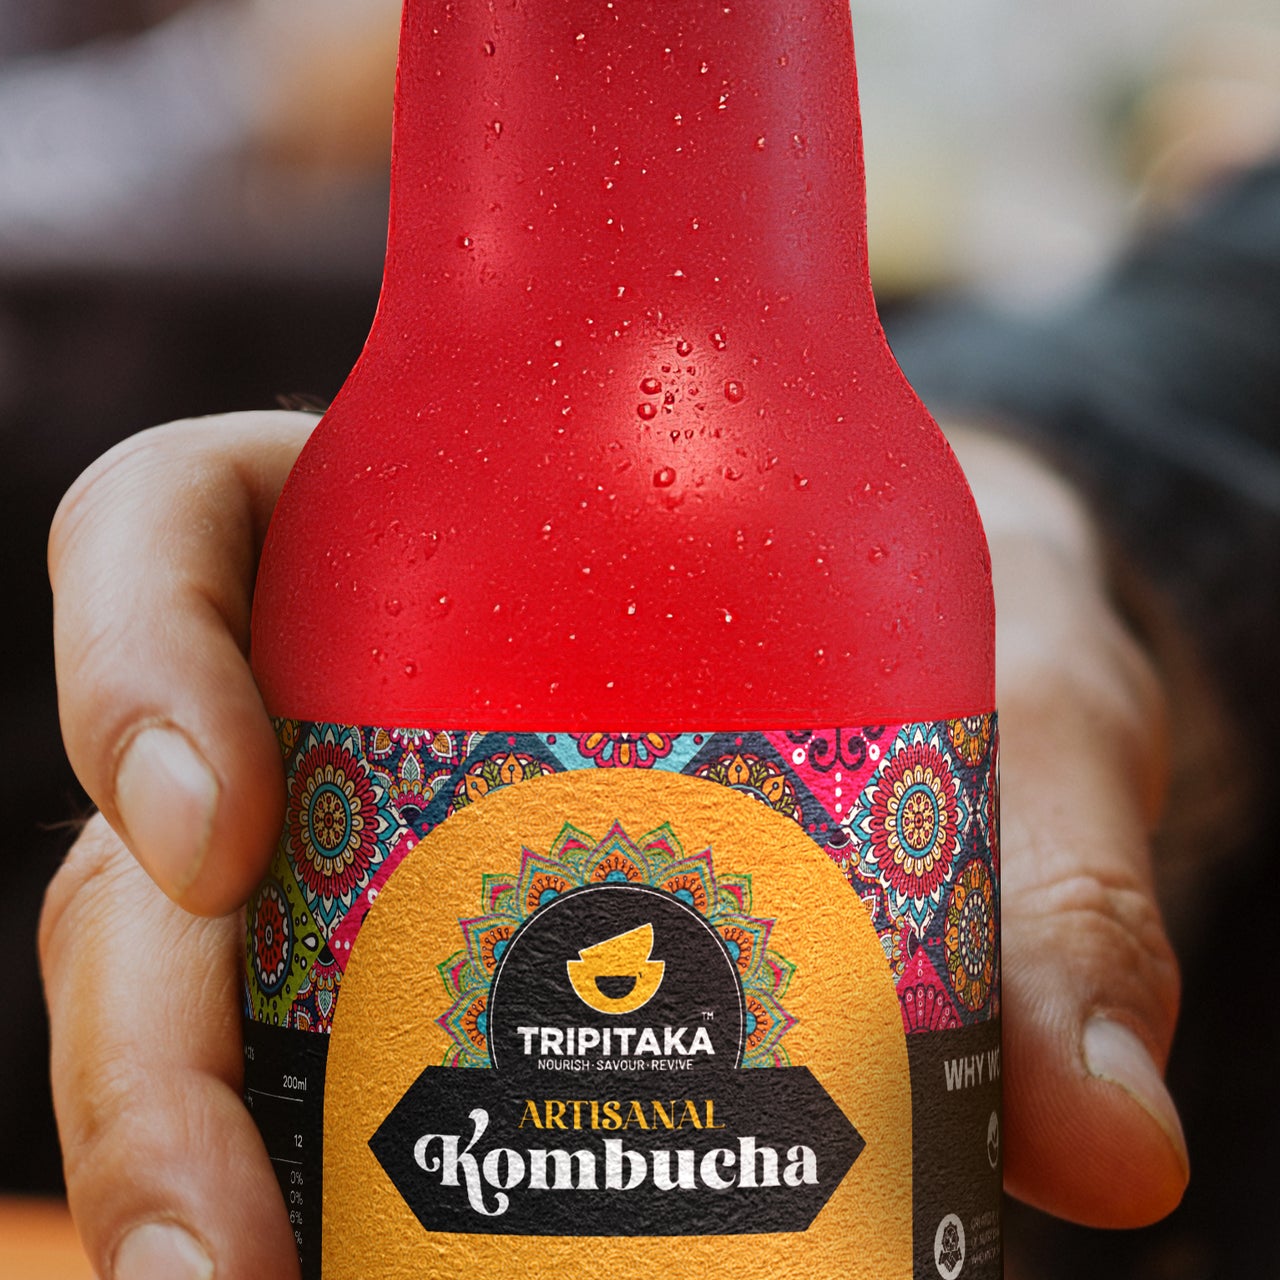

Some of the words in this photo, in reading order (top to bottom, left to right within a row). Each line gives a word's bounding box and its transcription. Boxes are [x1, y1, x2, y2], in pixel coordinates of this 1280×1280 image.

[517, 1027, 715, 1056] TRIPITAKA
[538, 1059, 589, 1071] NOURISH
[596, 1059, 645, 1071] SAVOUR
[651, 1059, 693, 1070] REVIVE
[944, 1052, 984, 1091] WHY
[282, 1074, 307, 1091] 200ml
[518, 1099, 726, 1130] ARTISANAL
[293, 1134, 303, 1148] 12
[413, 1108, 820, 1216] Kombucha
